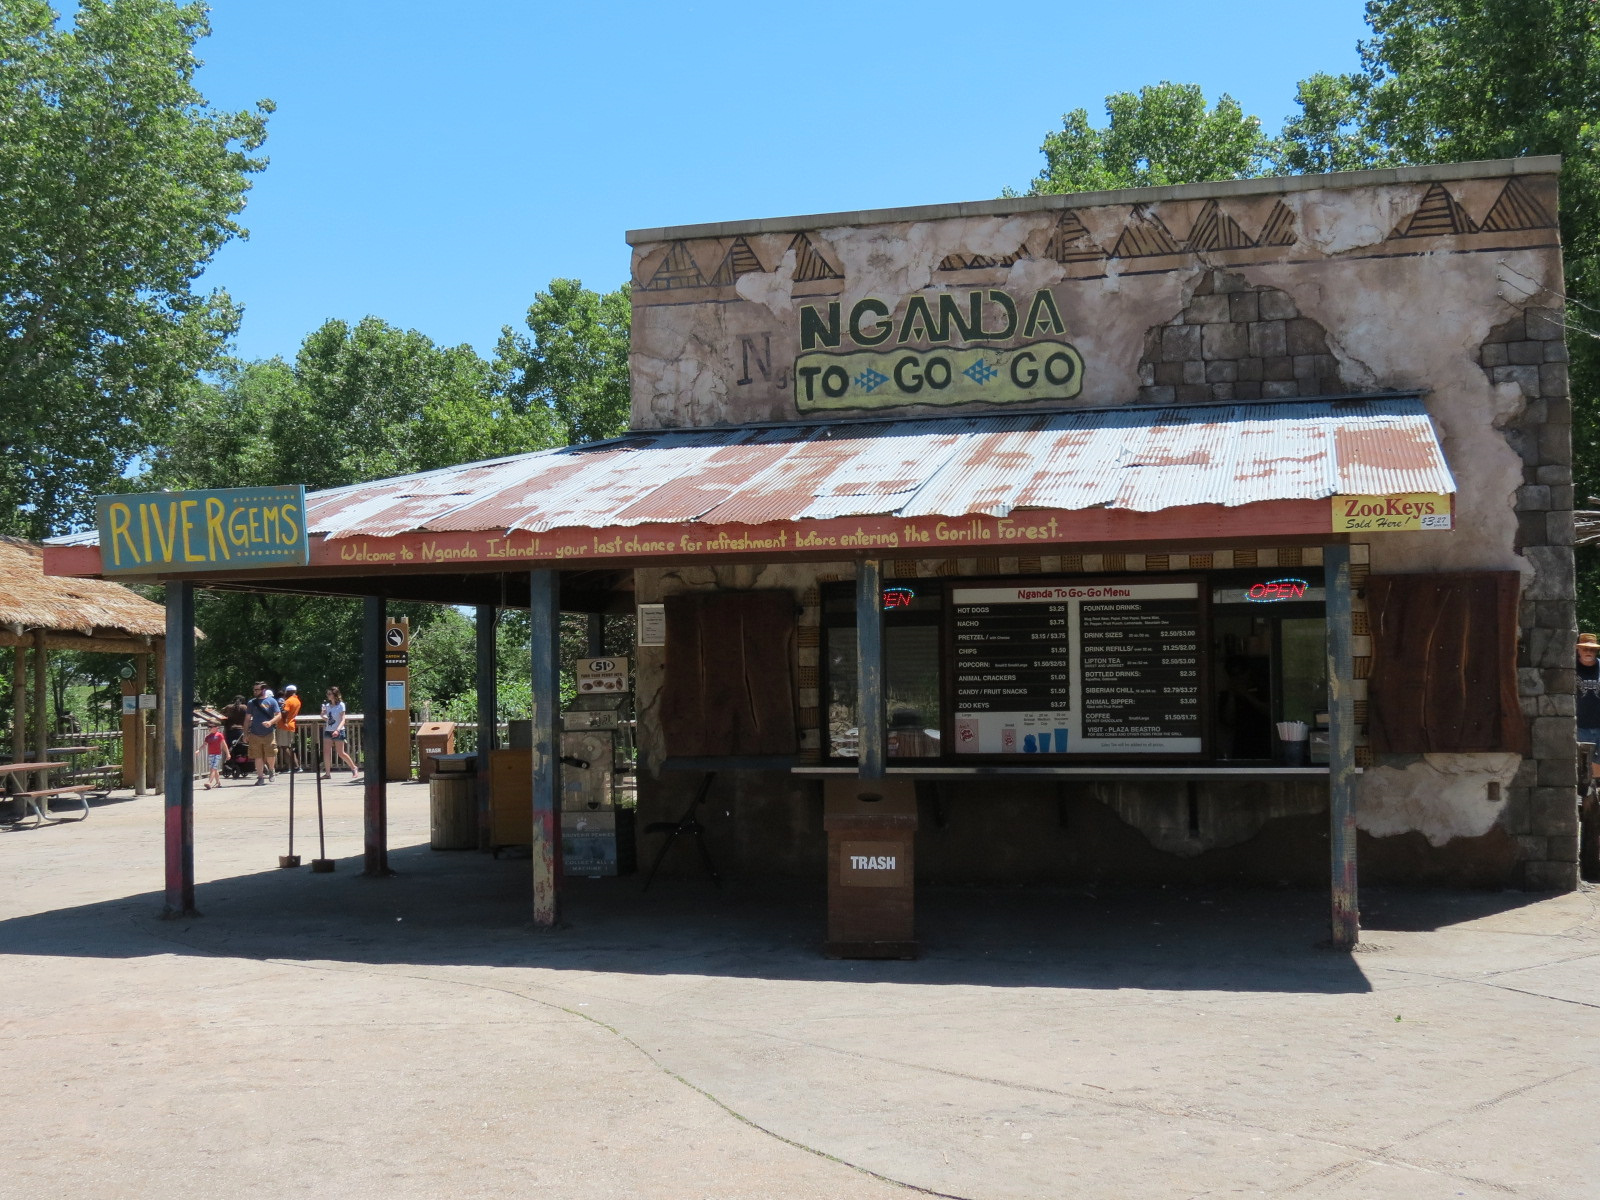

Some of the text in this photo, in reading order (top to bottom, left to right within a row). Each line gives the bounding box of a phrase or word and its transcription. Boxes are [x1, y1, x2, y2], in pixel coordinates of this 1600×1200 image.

[800, 289, 1066, 351] NGANDA
[799, 351, 1075, 401] TO GO GO
[1344, 498, 1435, 519] ZooKeys
[109, 497, 298, 566] RIVER GEMS
[1345, 518, 1372, 529] Sold
[341, 542, 396, 561] Welcome
[400, 544, 414, 560] to
[422, 541, 478, 562] Nganda
[555, 545, 588, 559] your
[593, 535, 622, 554] last
[624, 534, 675, 552] chance
[680, 534, 703, 552] for
[706, 529, 787, 550] refreshment
[795, 530, 837, 547] before
[840, 527, 899, 548] entering
[904, 524, 930, 542] the
[935, 519, 991, 540] Gorilla
[997, 516, 1063, 539] Forest.
[1018, 587, 1131, 600] Nganda To Go-Go Menu
[1249, 583, 1306, 598] OPEN
[850, 856, 896, 870] TRASH
